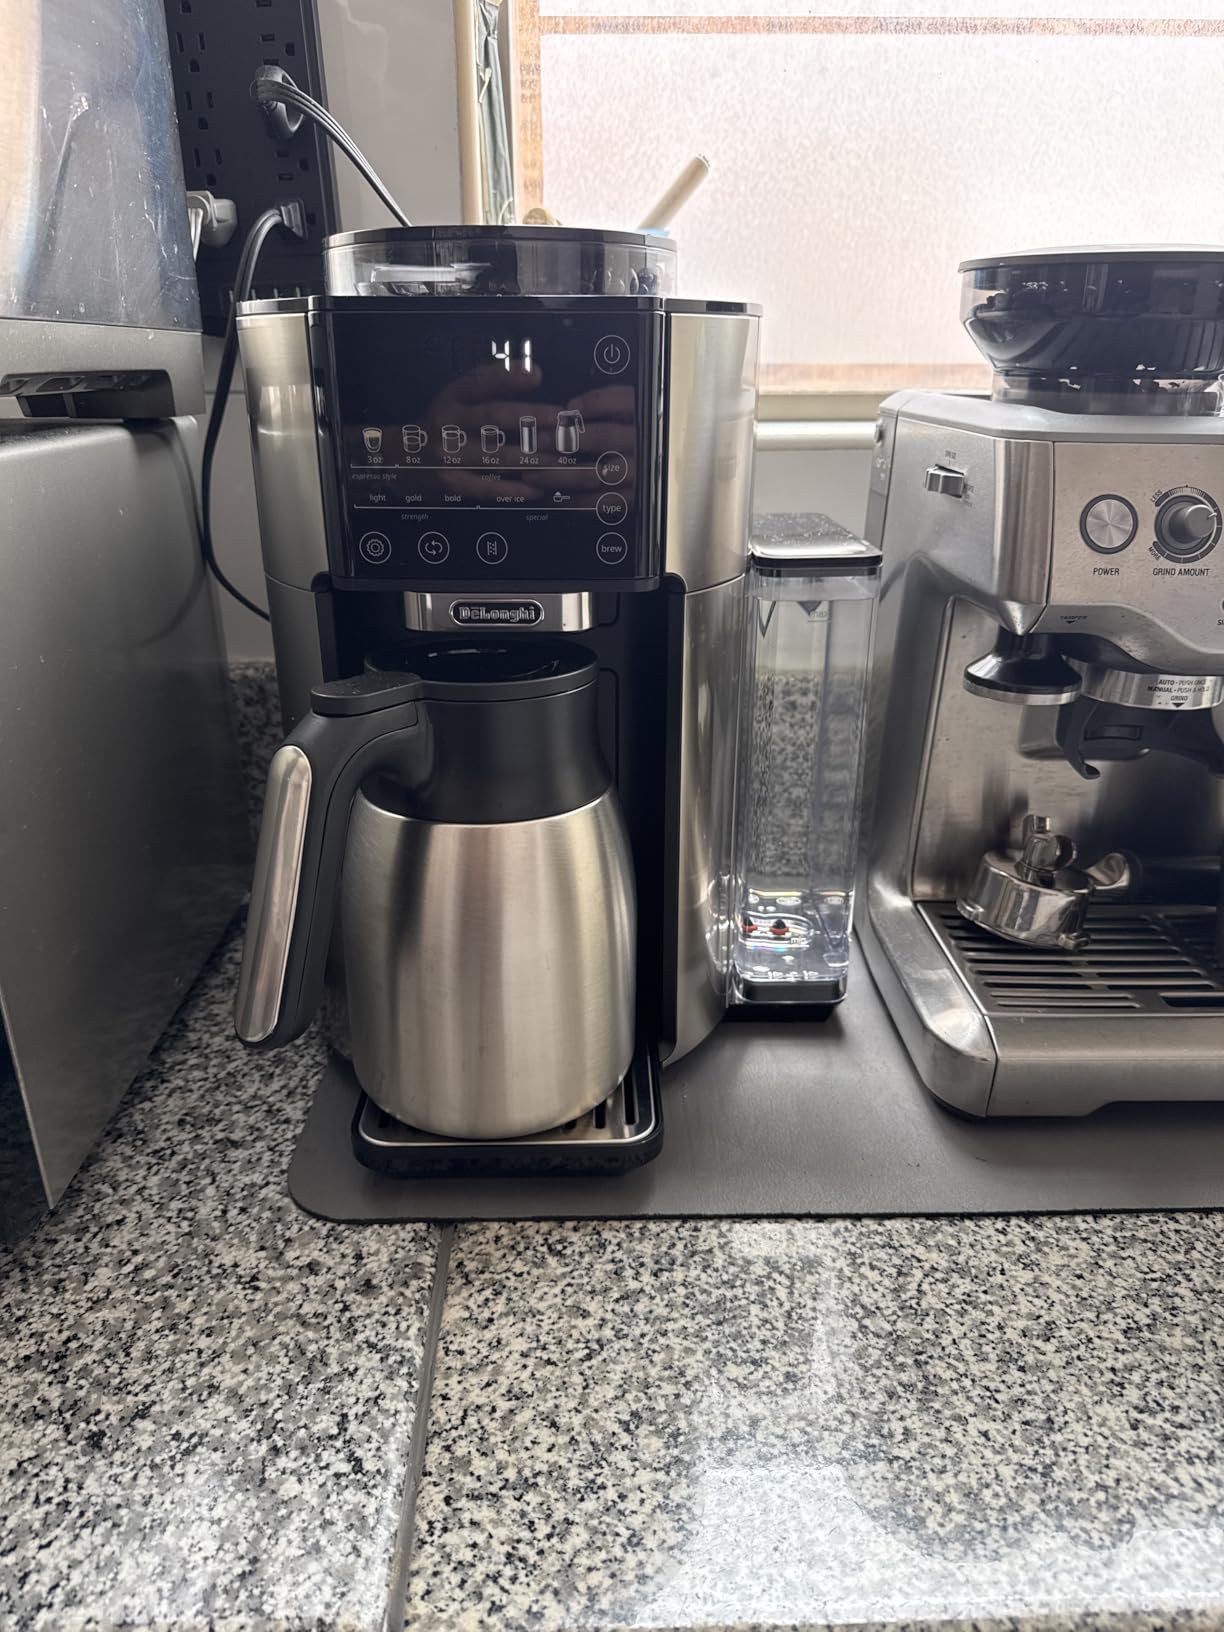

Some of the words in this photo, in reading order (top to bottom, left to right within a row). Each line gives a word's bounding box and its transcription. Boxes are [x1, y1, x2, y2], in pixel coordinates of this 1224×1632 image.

[491, 339, 531, 373] 41
[367, 456, 373, 464] 3
[406, 456, 411, 464] 8
[443, 456, 452, 464] 12
[482, 456, 490, 464] 16
[603, 464, 620, 472] size
[382, 472, 398, 481] style
[481, 473, 501, 481] coffee
[369, 494, 386, 503] light
[405, 494, 422, 503] gold
[444, 494, 462, 502] bold
[514, 495, 525, 503] ice
[1150, 490, 1163, 503] LESS
[602, 504, 622, 514] type
[401, 513, 429, 522] strength
[526, 513, 549, 522] special
[601, 544, 622, 553] brew
[1149, 546, 1161, 561] MORE
[1092, 567, 1120, 576] POWER
[1152, 567, 1176, 577] GRIND
[1178, 567, 1210, 577] AMOUNT
